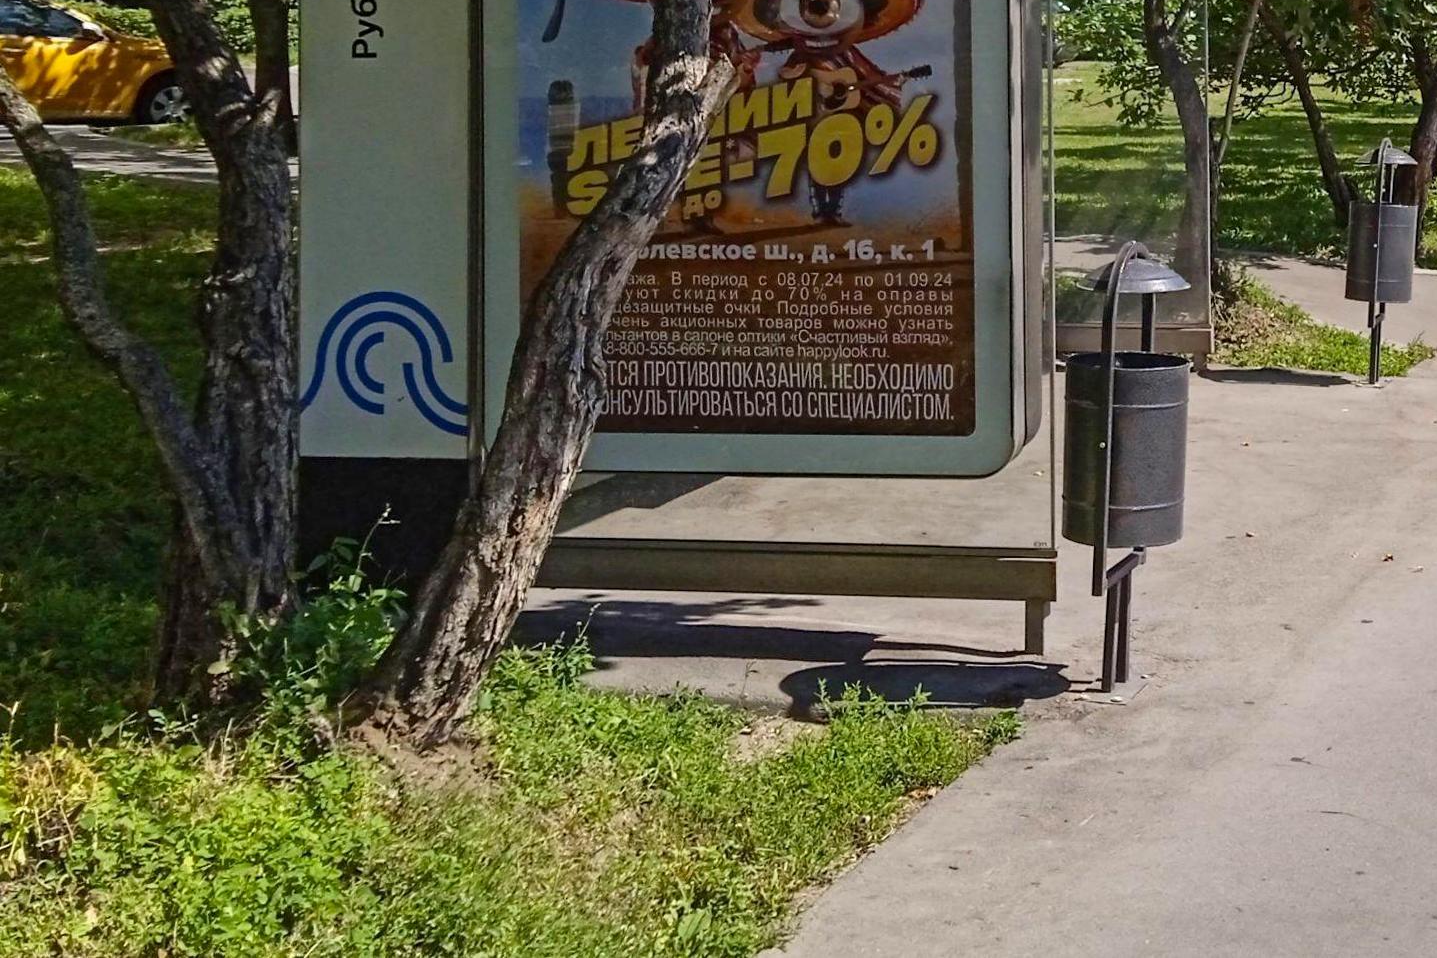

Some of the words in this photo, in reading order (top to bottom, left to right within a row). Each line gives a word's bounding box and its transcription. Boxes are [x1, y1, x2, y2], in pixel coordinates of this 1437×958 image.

[811, 244, 836, 264] д.
[843, 239, 883, 264] 16,
[891, 244, 914, 261] к.
[921, 239, 935, 260] 1
[671, 271, 682, 286] В
[692, 274, 749, 288] период
[758, 275, 768, 286] с
[777, 272, 843, 287] 08.07.24
[854, 276, 874, 287] по
[884, 272, 953, 287] 01.09.24
[672, 288, 739, 301] скидки
[751, 289, 775, 301] до
[788, 287, 827, 301] 70%
[841, 290, 864, 301] на
[877, 290, 953, 303] оправы
[777, 301, 873, 317] Подробные
[884, 304, 953, 318] условия
[660, 317, 746, 329] акционных
[758, 318, 822, 331] товаров
[833, 318, 888, 329] можно
[899, 318, 954, 332] узнать
[672, 332, 680, 342] в
[684, 332, 735, 343] салоне
[738, 332, 786, 343] оптики
[721, 345, 730, 356] и
[733, 345, 750, 356] на
[753, 345, 794, 357] сайте
[644, 360, 827, 389] ПРОТИВОПОКАЗАНИЯ.
[832, 363, 954, 393] НЕОБХОДИМО
[782, 392, 802, 418] СО
[807, 393, 955, 421] СПЕЦИАЛИСТОМ.
